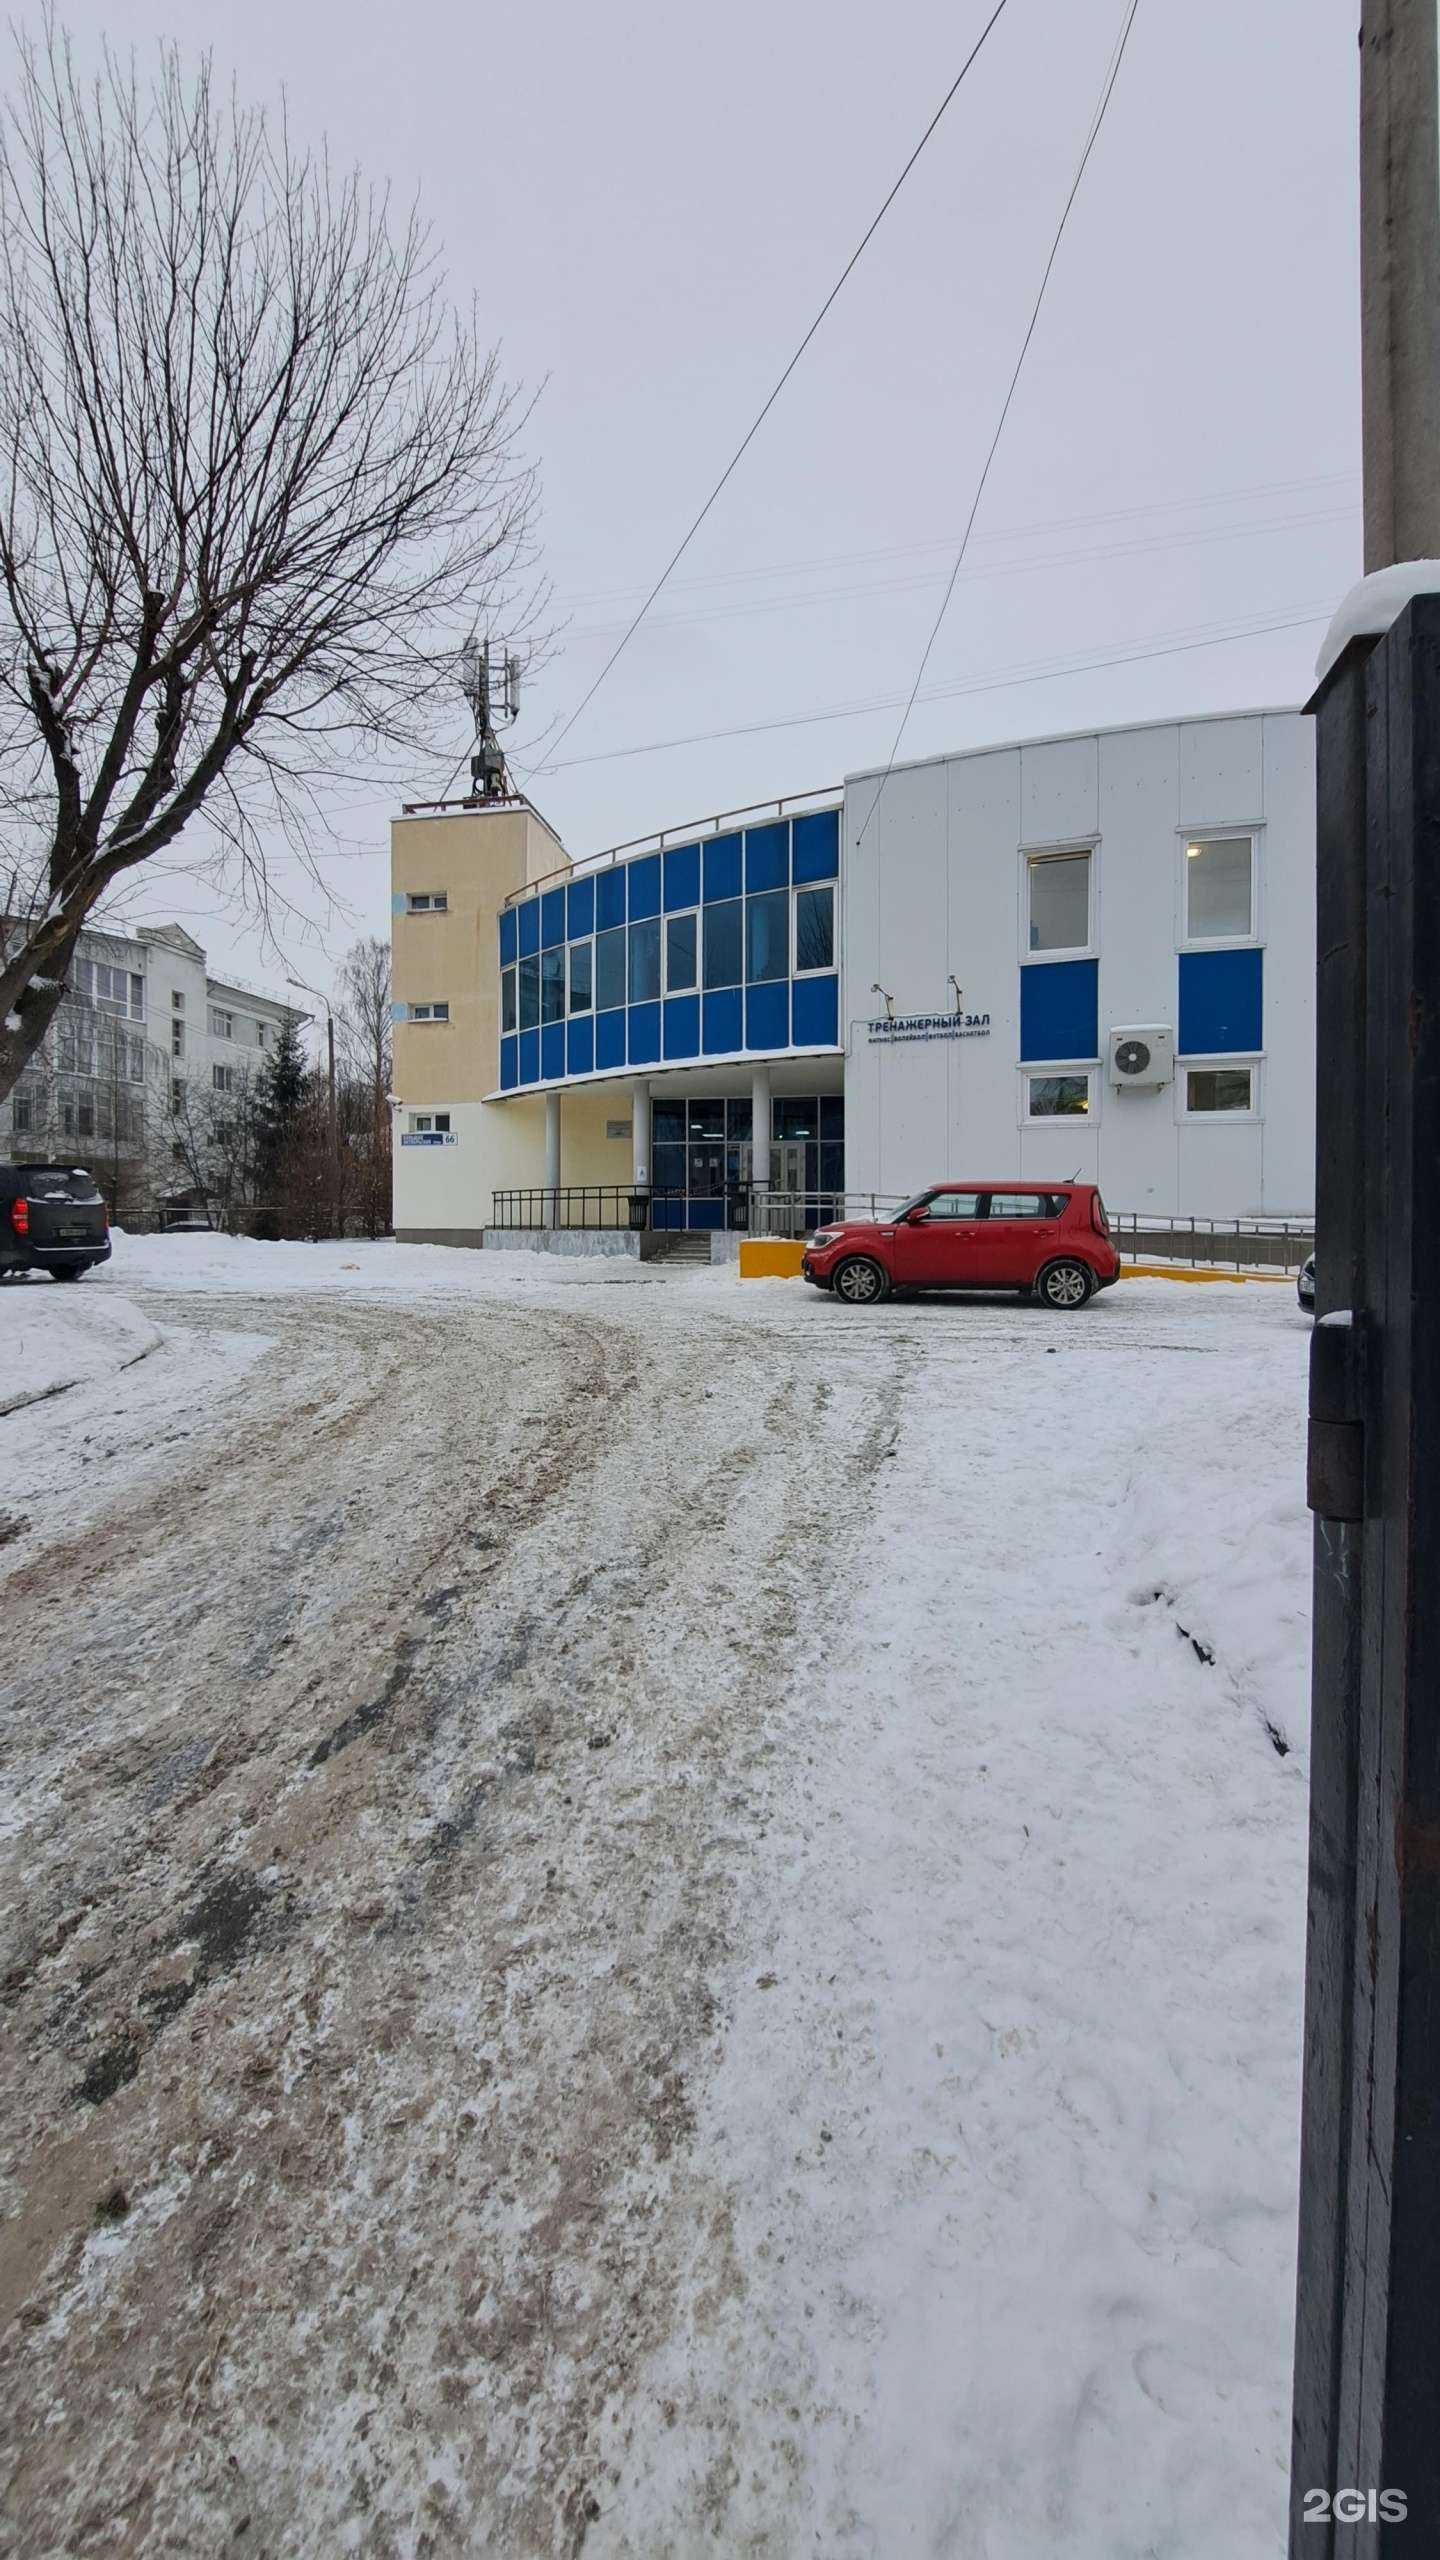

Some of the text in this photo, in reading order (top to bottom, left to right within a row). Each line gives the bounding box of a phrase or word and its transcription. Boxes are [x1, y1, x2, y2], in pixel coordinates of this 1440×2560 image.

[868, 1014, 990, 1033] ТРЕНАЖЕРНЫЙ ЗАЛ
[445, 1134, 455, 1144] 66
